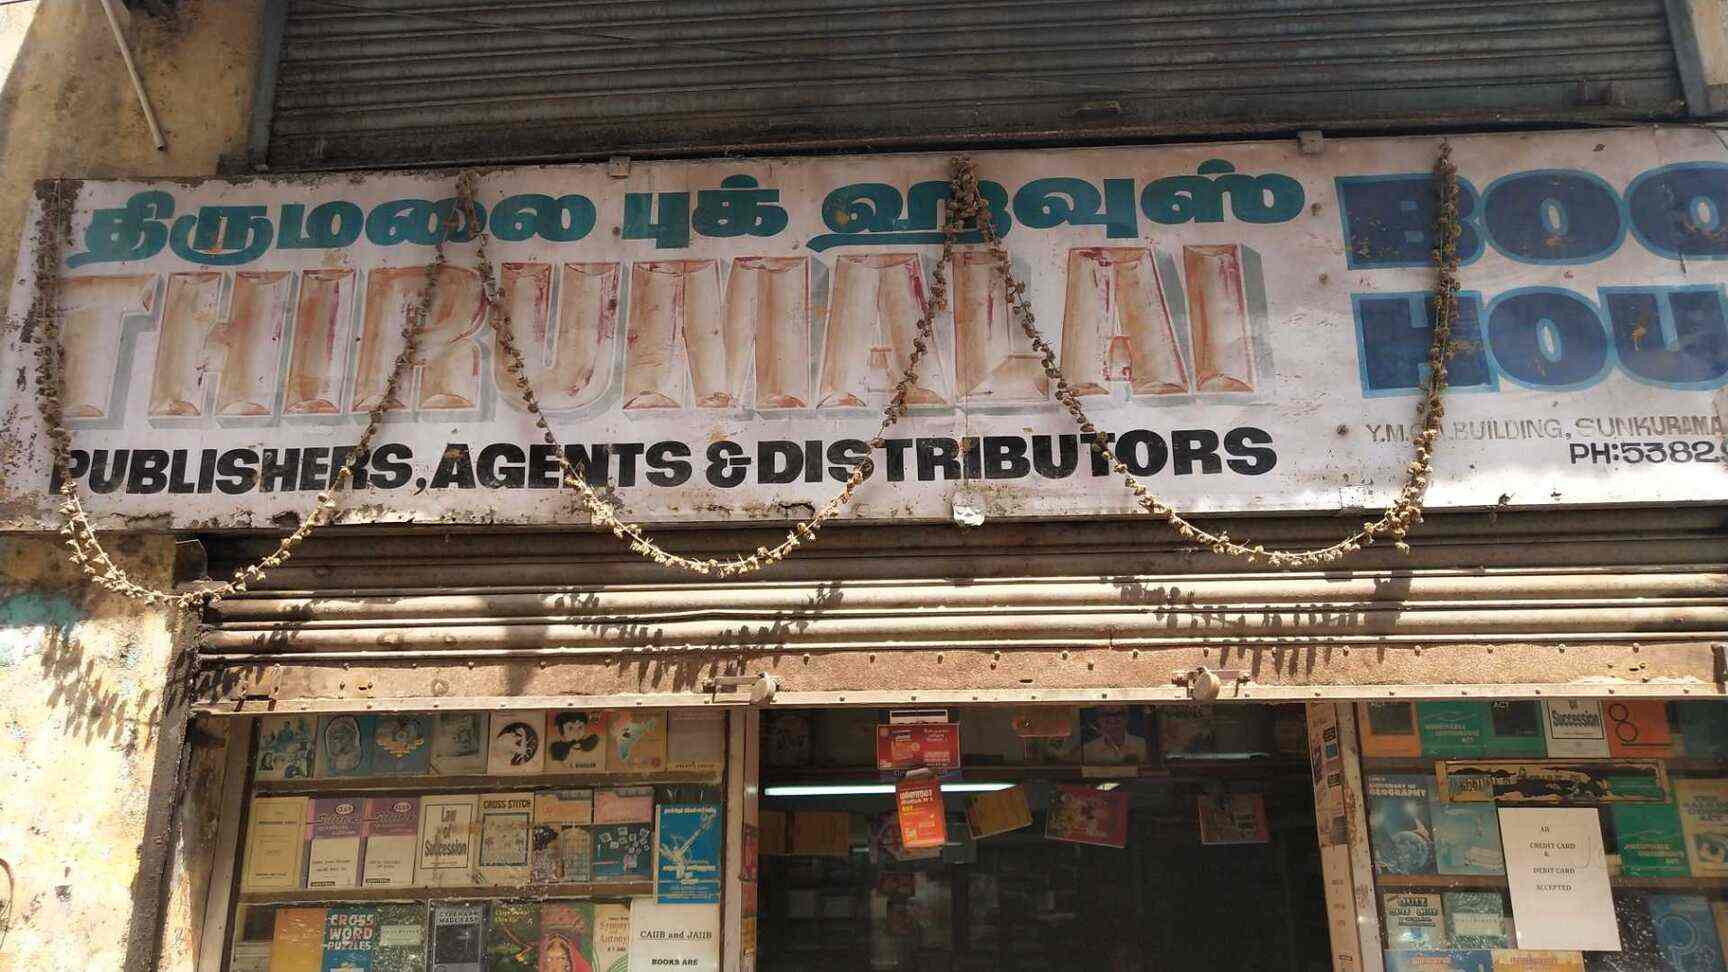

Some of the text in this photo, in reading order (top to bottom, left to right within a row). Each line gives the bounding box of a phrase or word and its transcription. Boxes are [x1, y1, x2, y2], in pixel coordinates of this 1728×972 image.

[621, 174, 788, 249] புக்
[60, 242, 1273, 430] THIRUMALAI
[431, 440, 692, 490] AGENTS
[706, 440, 751, 487] &
[757, 427, 1278, 485] DISTRIBUTORS
[329, 914, 375, 926] CROSS
[329, 927, 373, 941] WORD
[668, 930, 684, 939] and
[327, 941, 372, 951] PUZZLES
[651, 958, 698, 966] BOOKS ARE
